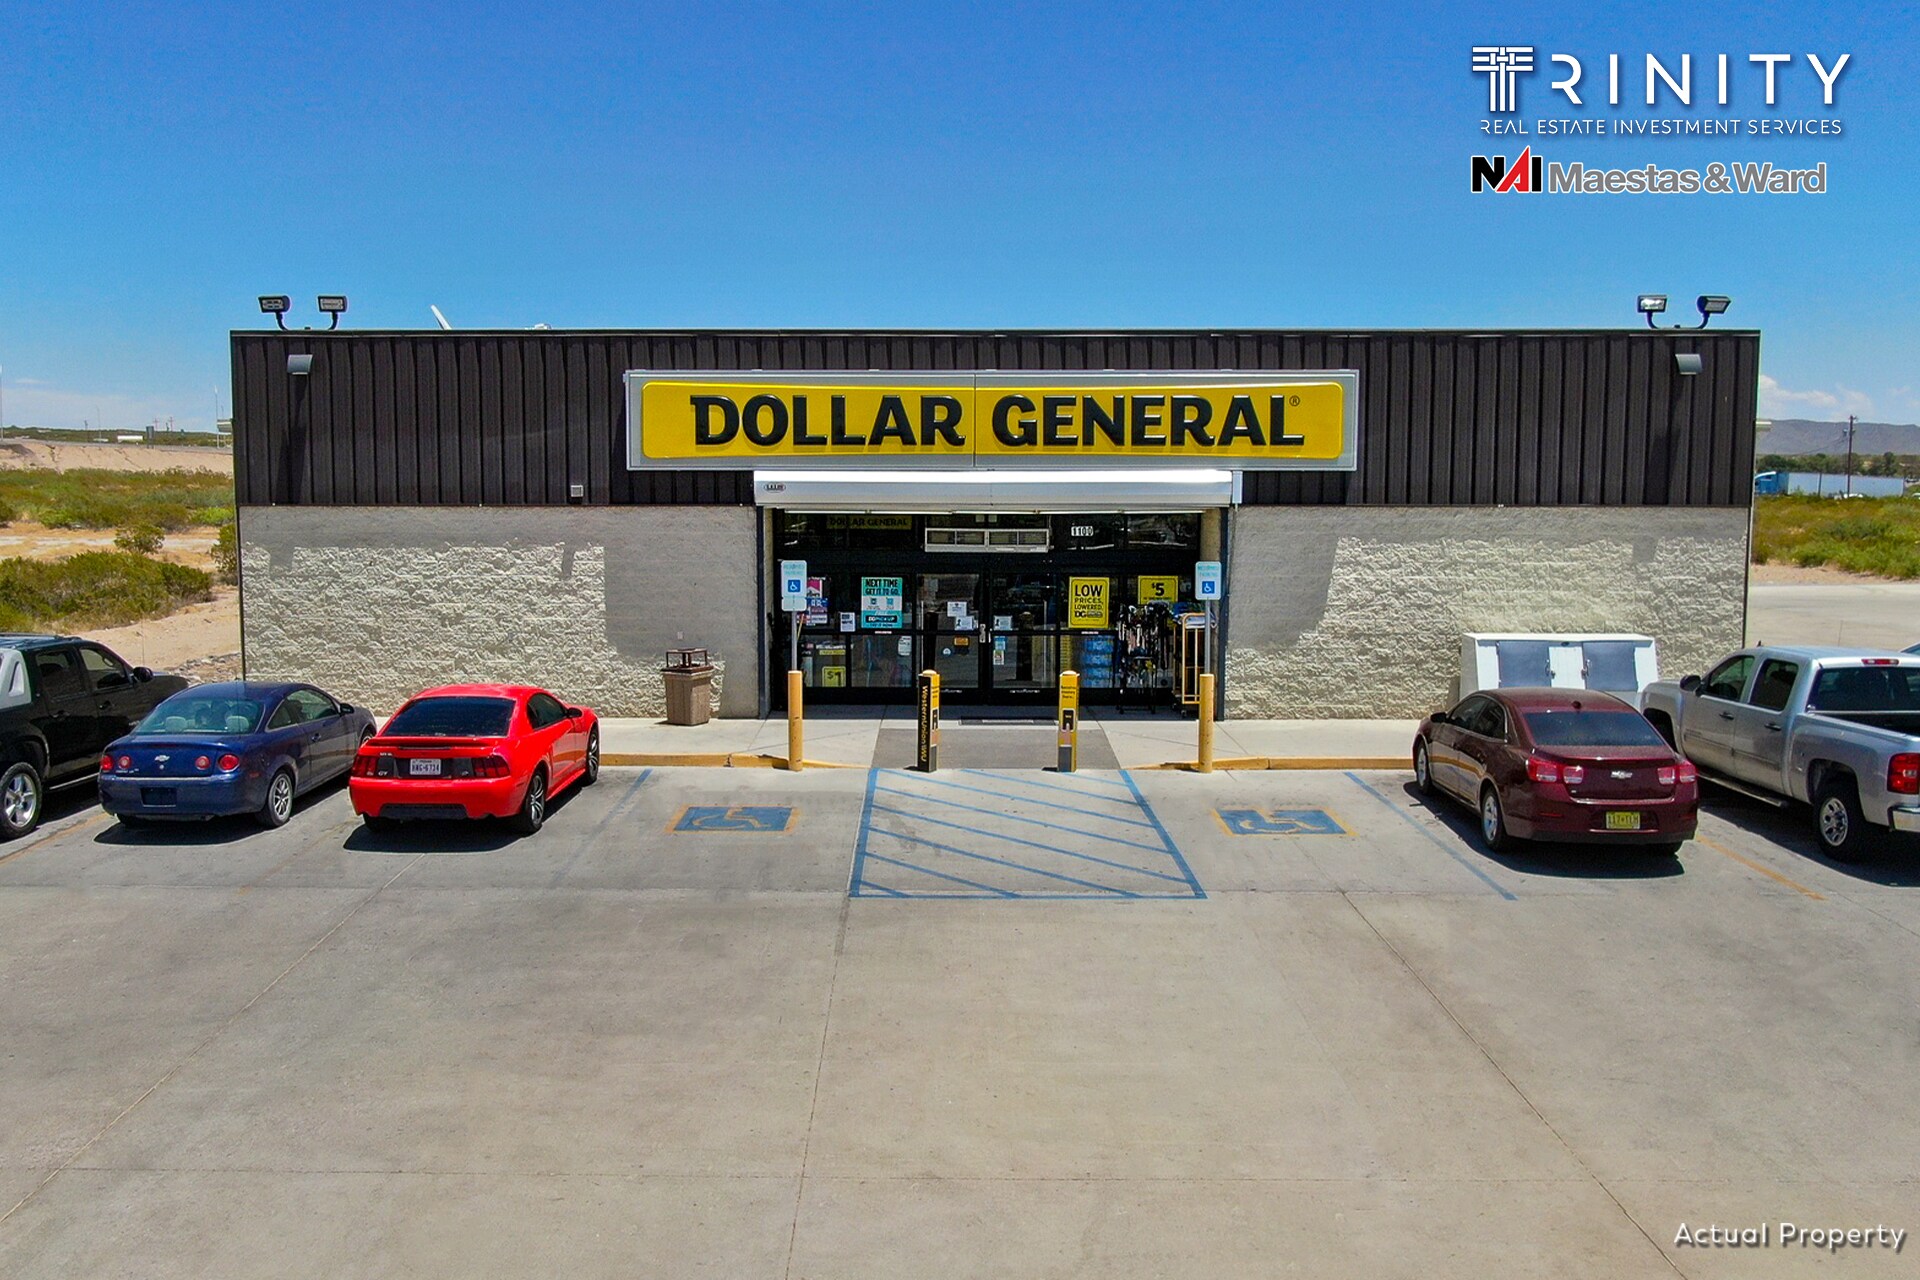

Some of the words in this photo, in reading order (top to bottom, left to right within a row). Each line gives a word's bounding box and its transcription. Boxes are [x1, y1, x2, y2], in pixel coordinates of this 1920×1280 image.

[690, 394, 966, 447] DOLLAR
[865, 578, 881, 588] NEXT
[883, 578, 898, 588] TIME
[1074, 584, 1102, 597] LOW
